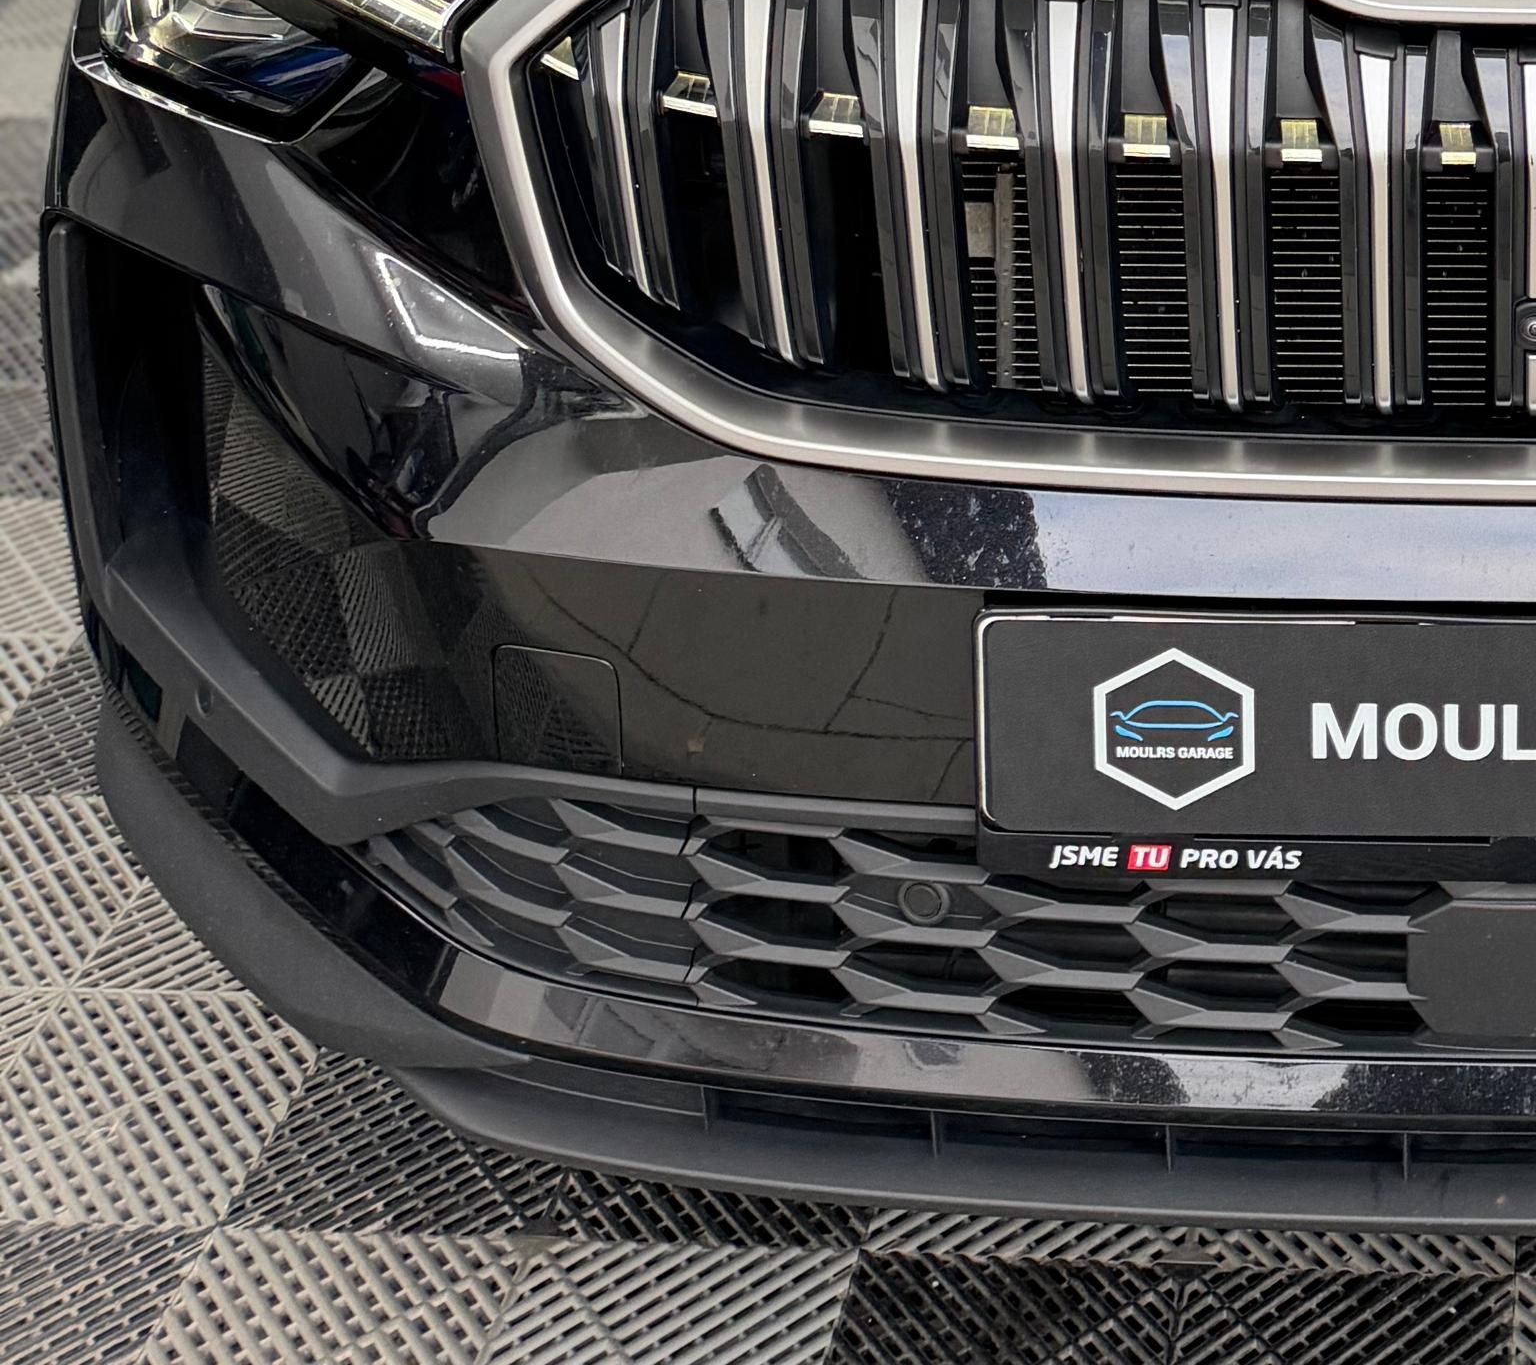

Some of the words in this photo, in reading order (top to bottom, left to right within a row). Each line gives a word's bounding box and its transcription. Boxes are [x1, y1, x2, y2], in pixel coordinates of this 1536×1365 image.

[1115, 745, 1176, 759] MOULRS
[1178, 746, 1234, 760] GARAGE
[1049, 845, 1119, 869] JSME
[1132, 846, 1172, 869] TU
[1180, 848, 1239, 869] PRO
[1246, 845, 1303, 870] VÁS
